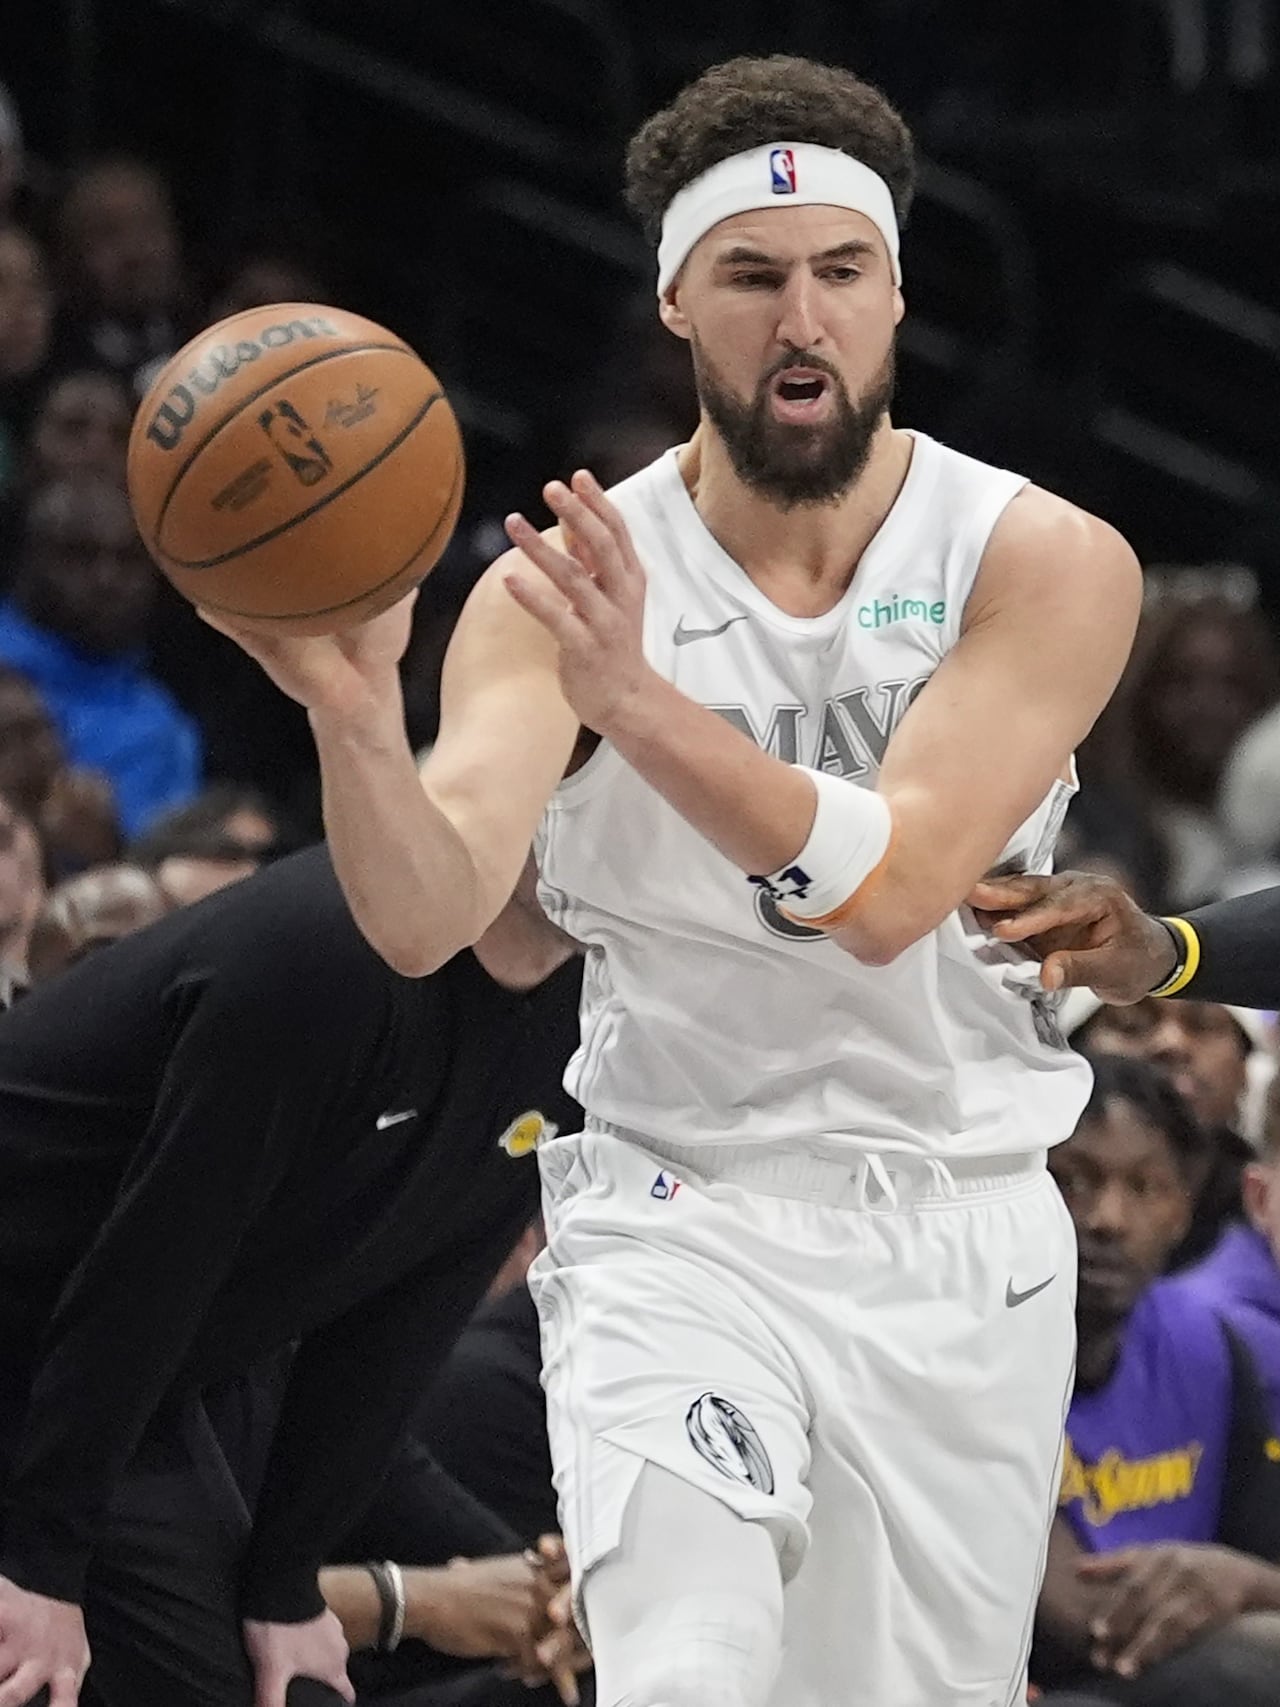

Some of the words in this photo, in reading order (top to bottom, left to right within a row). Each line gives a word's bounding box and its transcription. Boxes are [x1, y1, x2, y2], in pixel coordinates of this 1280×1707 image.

[147, 318, 337, 450] Wilson
[858, 594, 945, 628] chime
[704, 678, 929, 780] MAV
